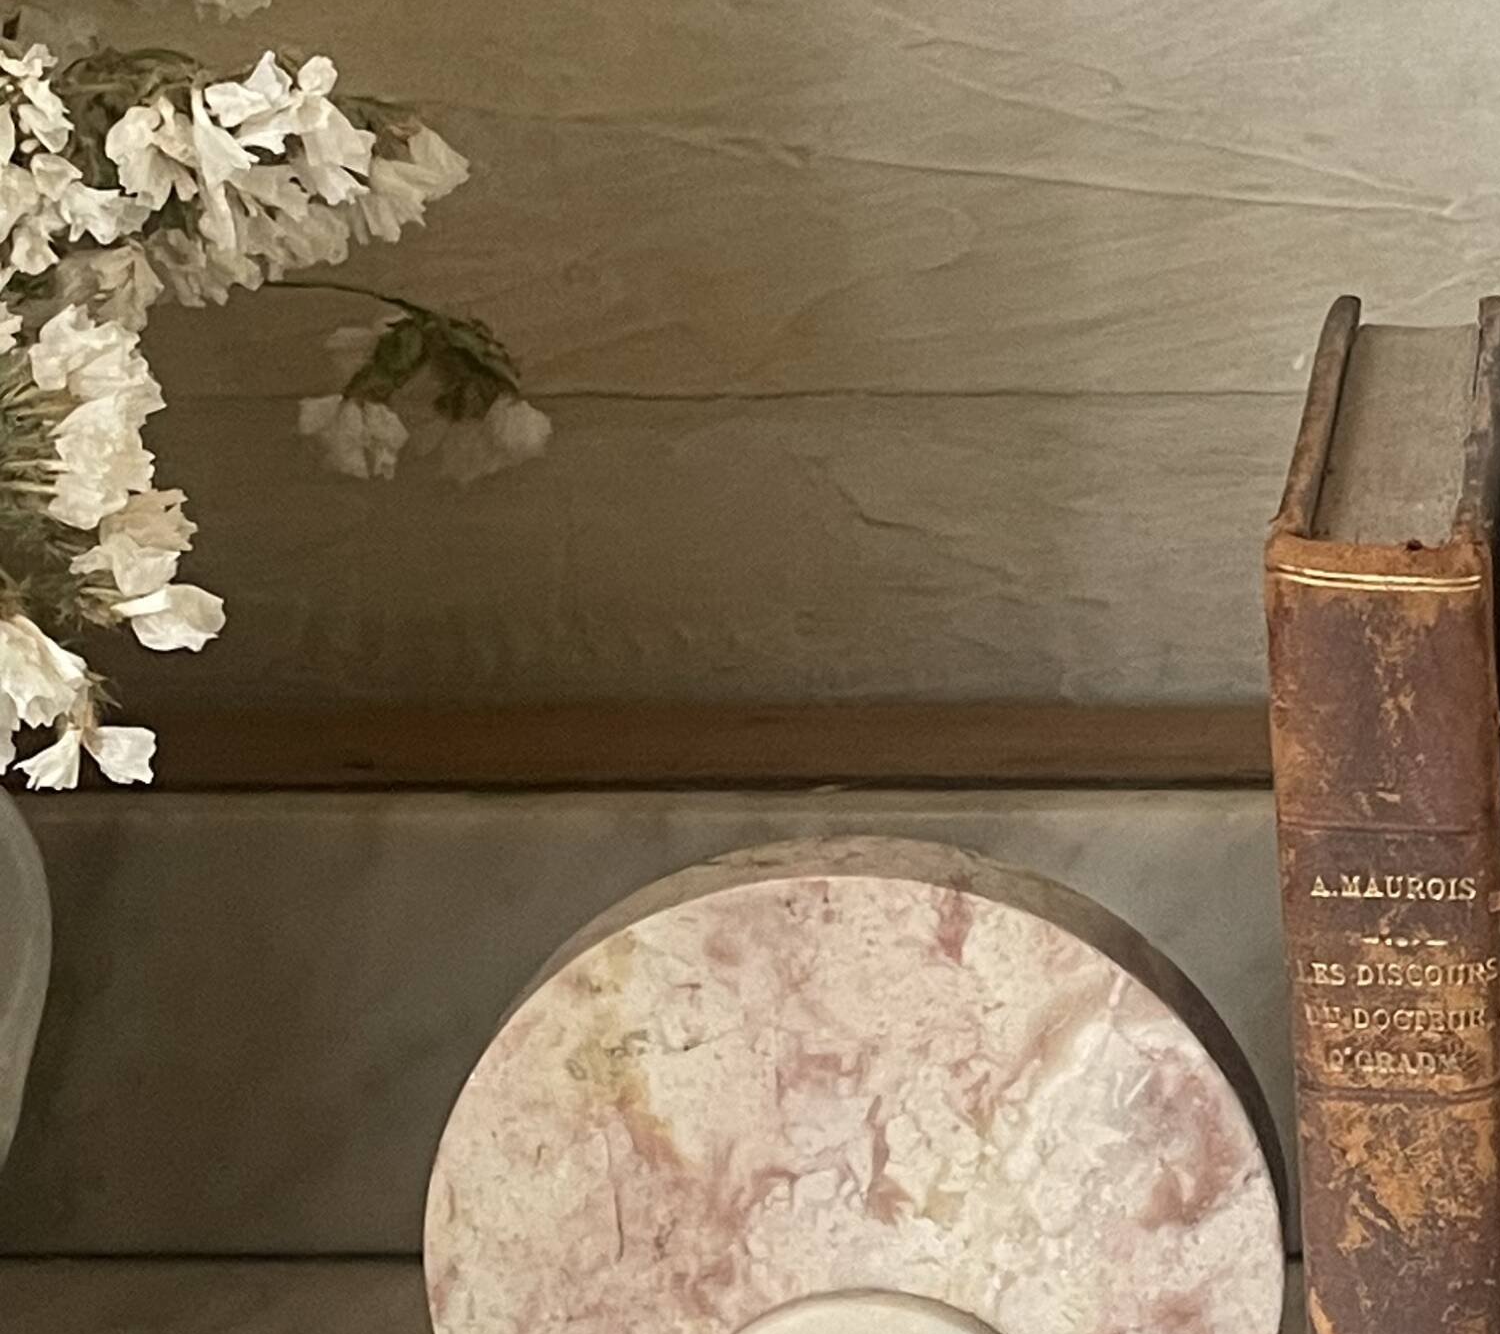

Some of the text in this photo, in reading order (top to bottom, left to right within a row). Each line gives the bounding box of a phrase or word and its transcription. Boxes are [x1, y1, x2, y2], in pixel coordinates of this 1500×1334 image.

[1310, 874, 1477, 901] A.MAUROIS
[1297, 957, 1499, 987] LES DISCOURS
